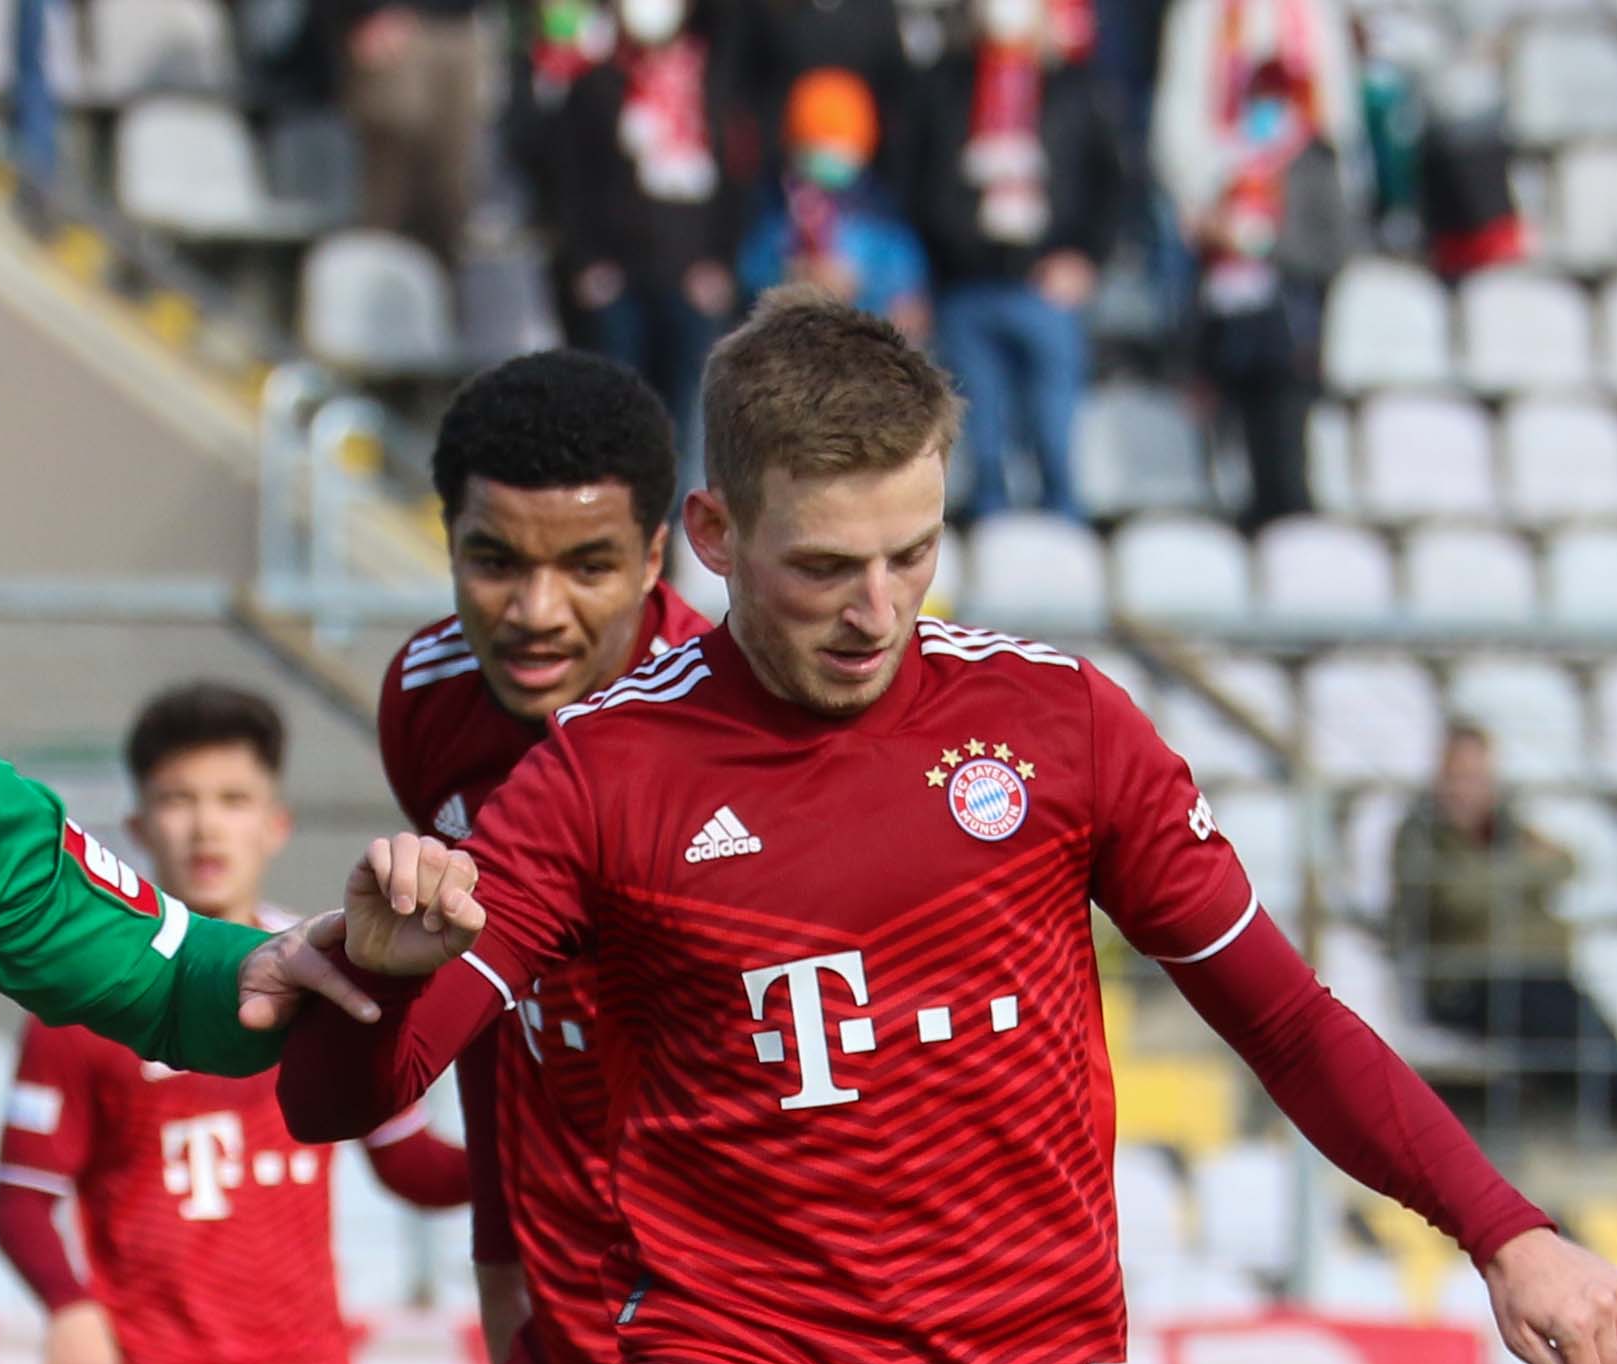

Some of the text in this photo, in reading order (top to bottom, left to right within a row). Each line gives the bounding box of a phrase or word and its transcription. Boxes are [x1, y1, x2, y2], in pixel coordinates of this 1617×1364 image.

[954, 765, 1017, 798] FC BAYERN
[684, 836, 763, 863] adidas
